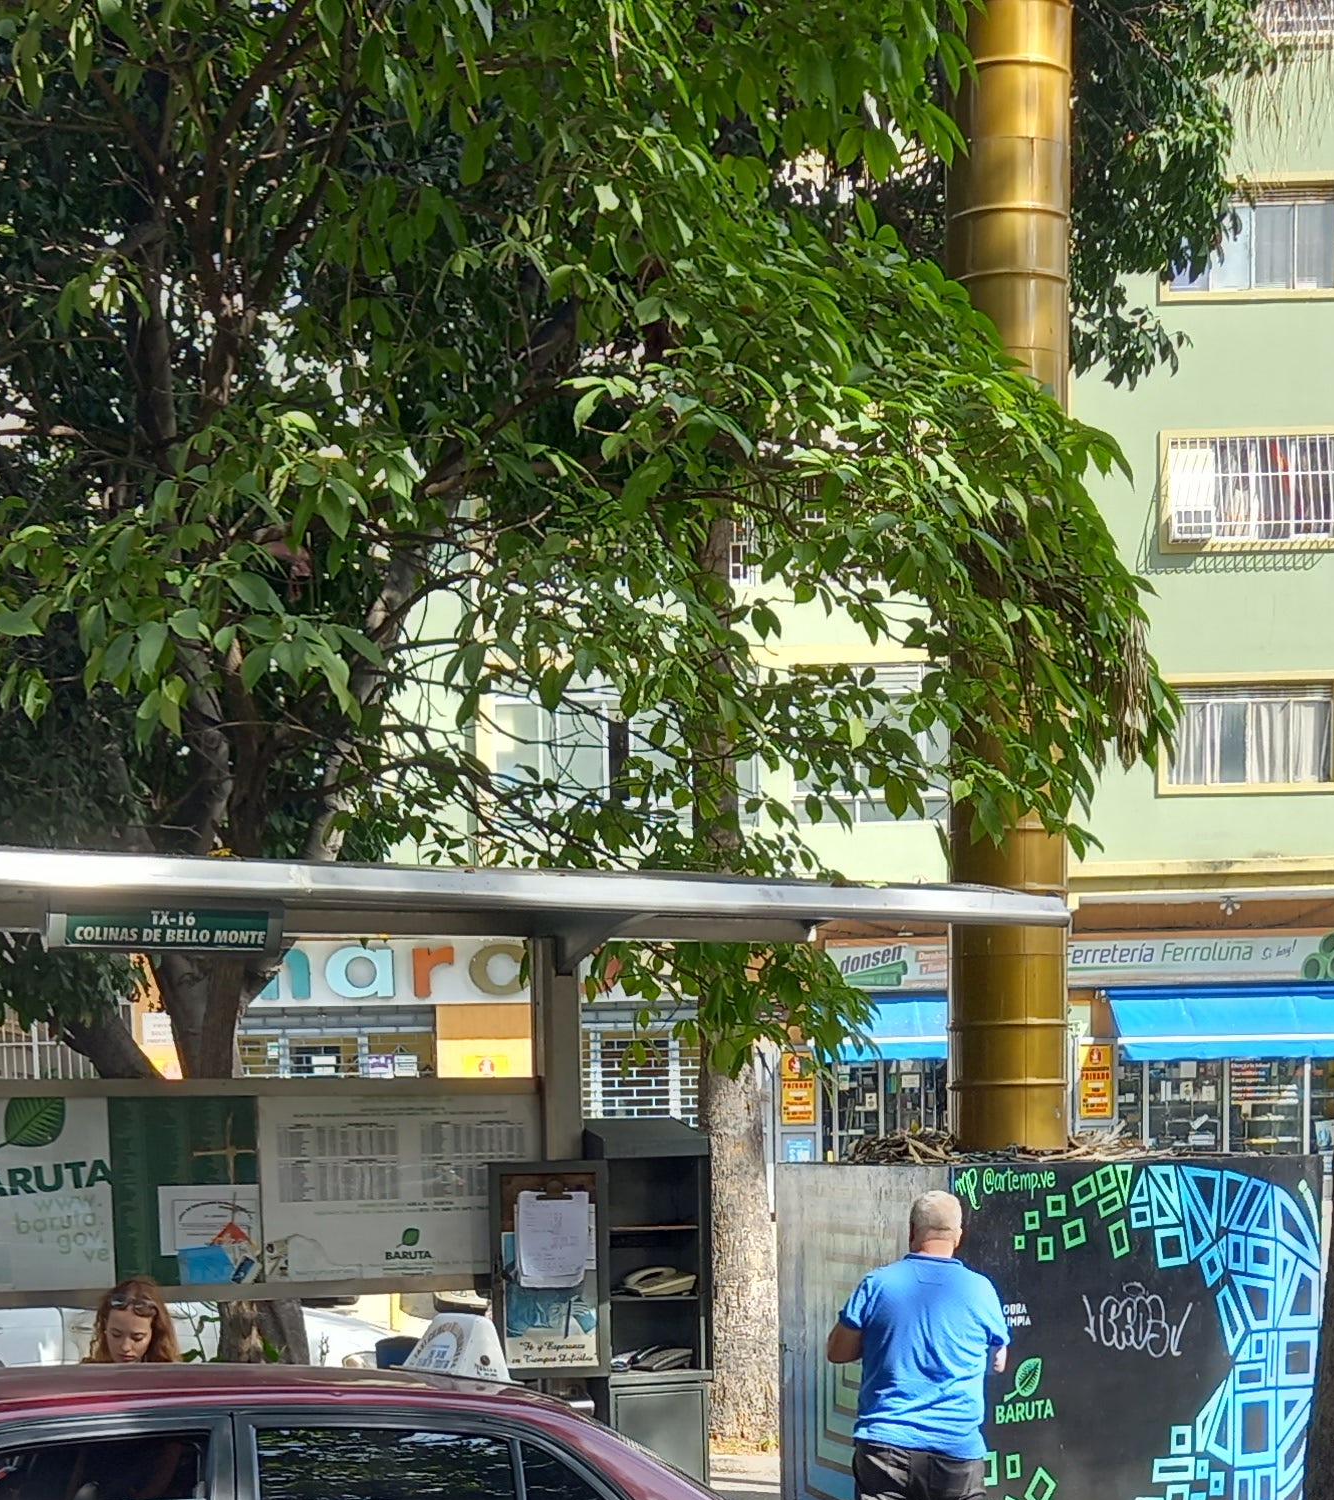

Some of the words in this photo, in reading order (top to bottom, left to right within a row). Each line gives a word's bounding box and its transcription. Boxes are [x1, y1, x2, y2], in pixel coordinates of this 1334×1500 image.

[74, 926, 138, 941] COLINAS
[142, 928, 162, 942] DE
[166, 928, 210, 943] BELLO
[214, 930, 267, 944] MONTE
[1080, 1072, 1110, 1081] PRIVADO
[384, 1250, 433, 1261] BARUTA
[1004, 1315, 1032, 1328] IMPIA
[994, 1398, 1055, 1425] BARUTA
